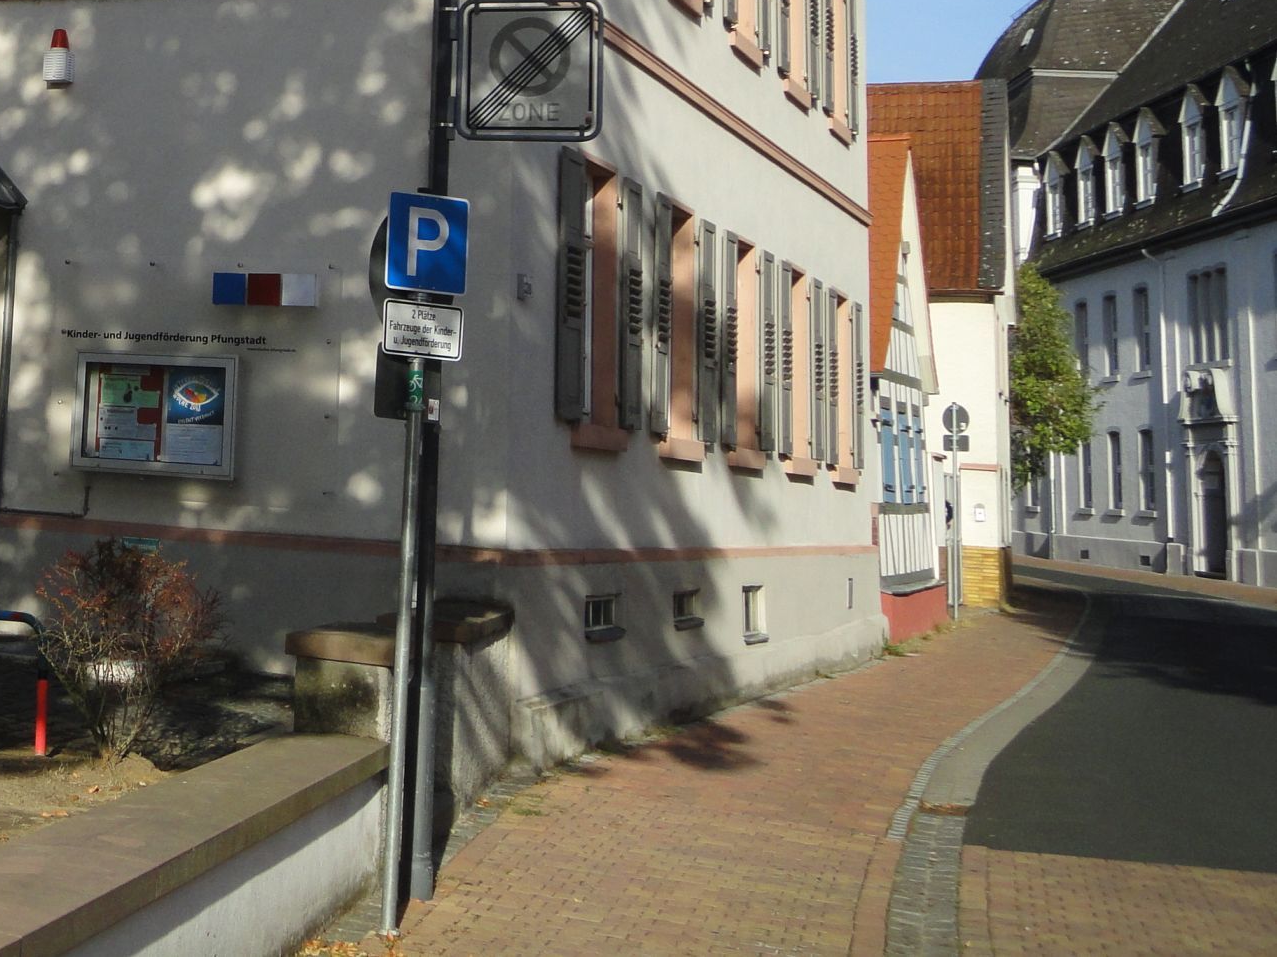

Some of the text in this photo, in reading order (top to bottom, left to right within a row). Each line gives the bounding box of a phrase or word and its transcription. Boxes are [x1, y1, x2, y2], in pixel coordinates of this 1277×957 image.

[498, 102, 560, 122] ZONE
[406, 206, 450, 277] P
[411, 309, 437, 321] 2 Plätze
[389, 320, 457, 337] Fahrzeuge der Kinder-
[66, 329, 267, 346] Kinder- und Jugendförderung Pfungstadt
[400, 335, 452, 352] Jugendförderung
